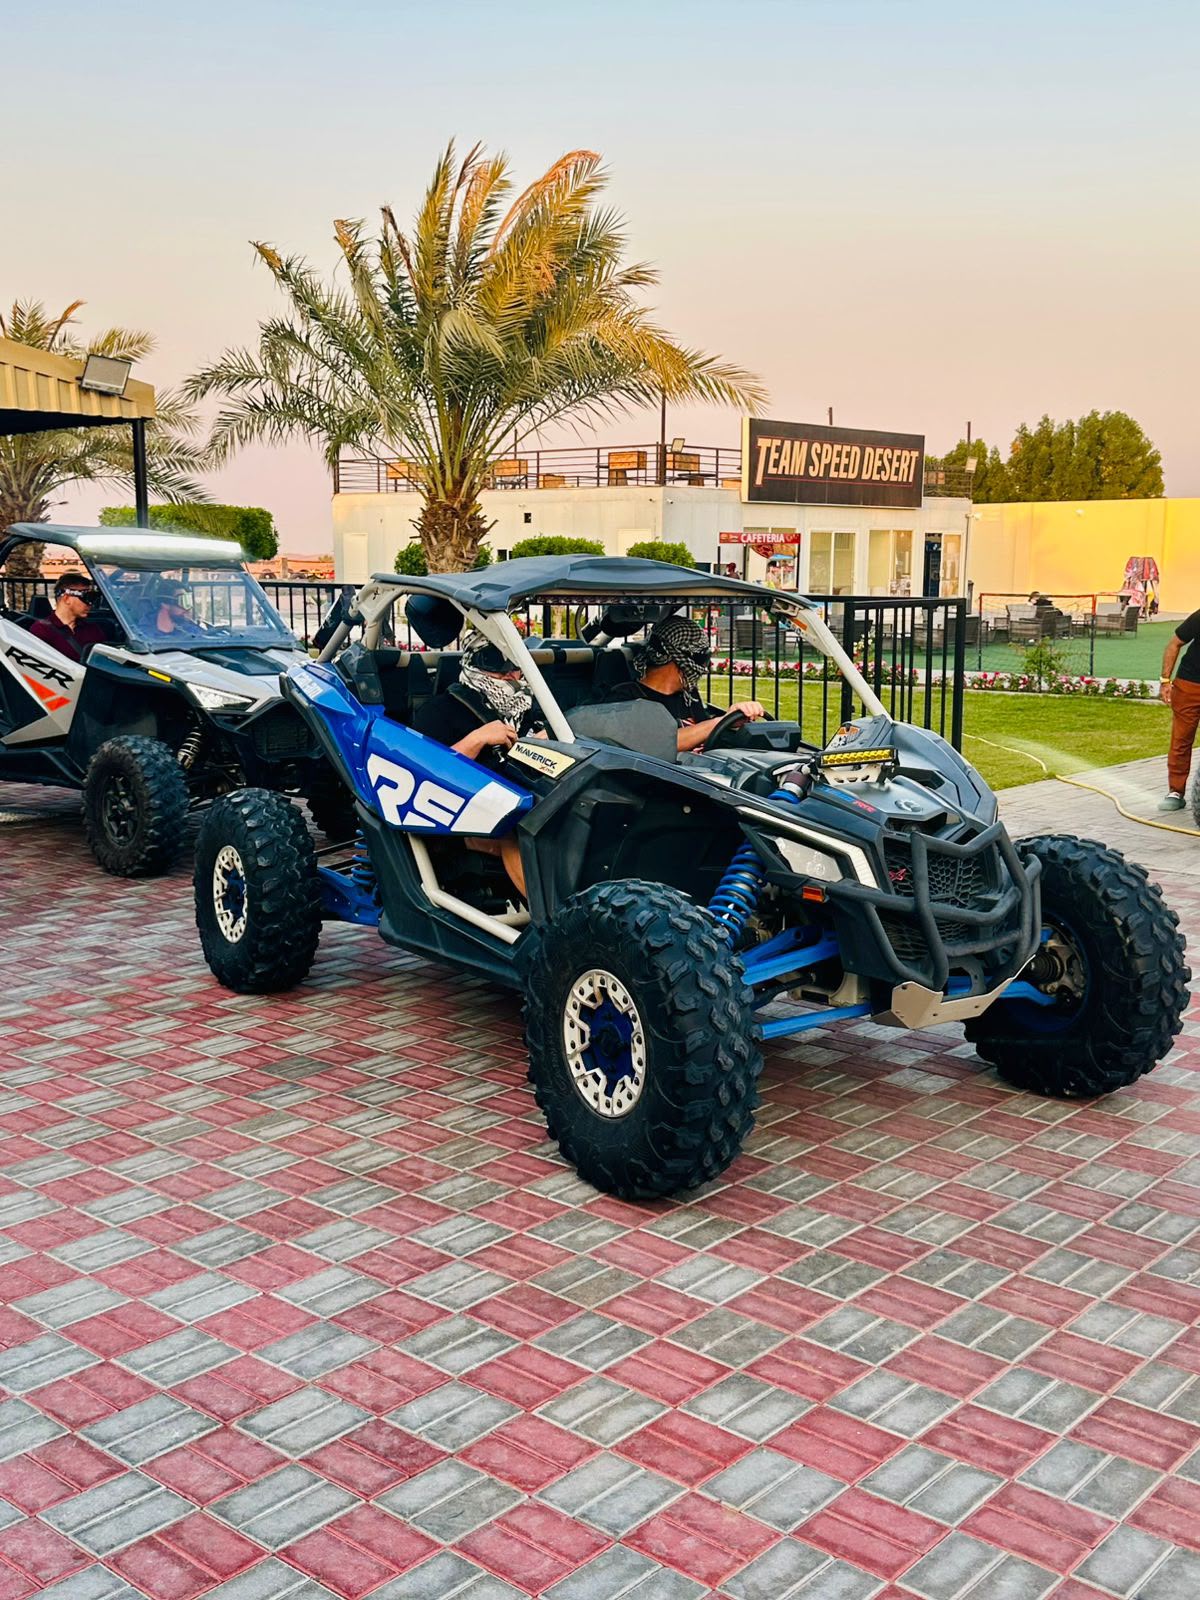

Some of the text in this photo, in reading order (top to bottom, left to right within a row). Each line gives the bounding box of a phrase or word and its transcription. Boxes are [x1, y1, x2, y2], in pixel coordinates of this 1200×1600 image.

[755, 437, 919, 485] TEAM SPEED DESERT
[740, 533, 785, 543] CAFETERIA
[5, 645, 75, 690] RZR
[515, 744, 558, 769] MAVERICK
[367, 753, 466, 828] RS
